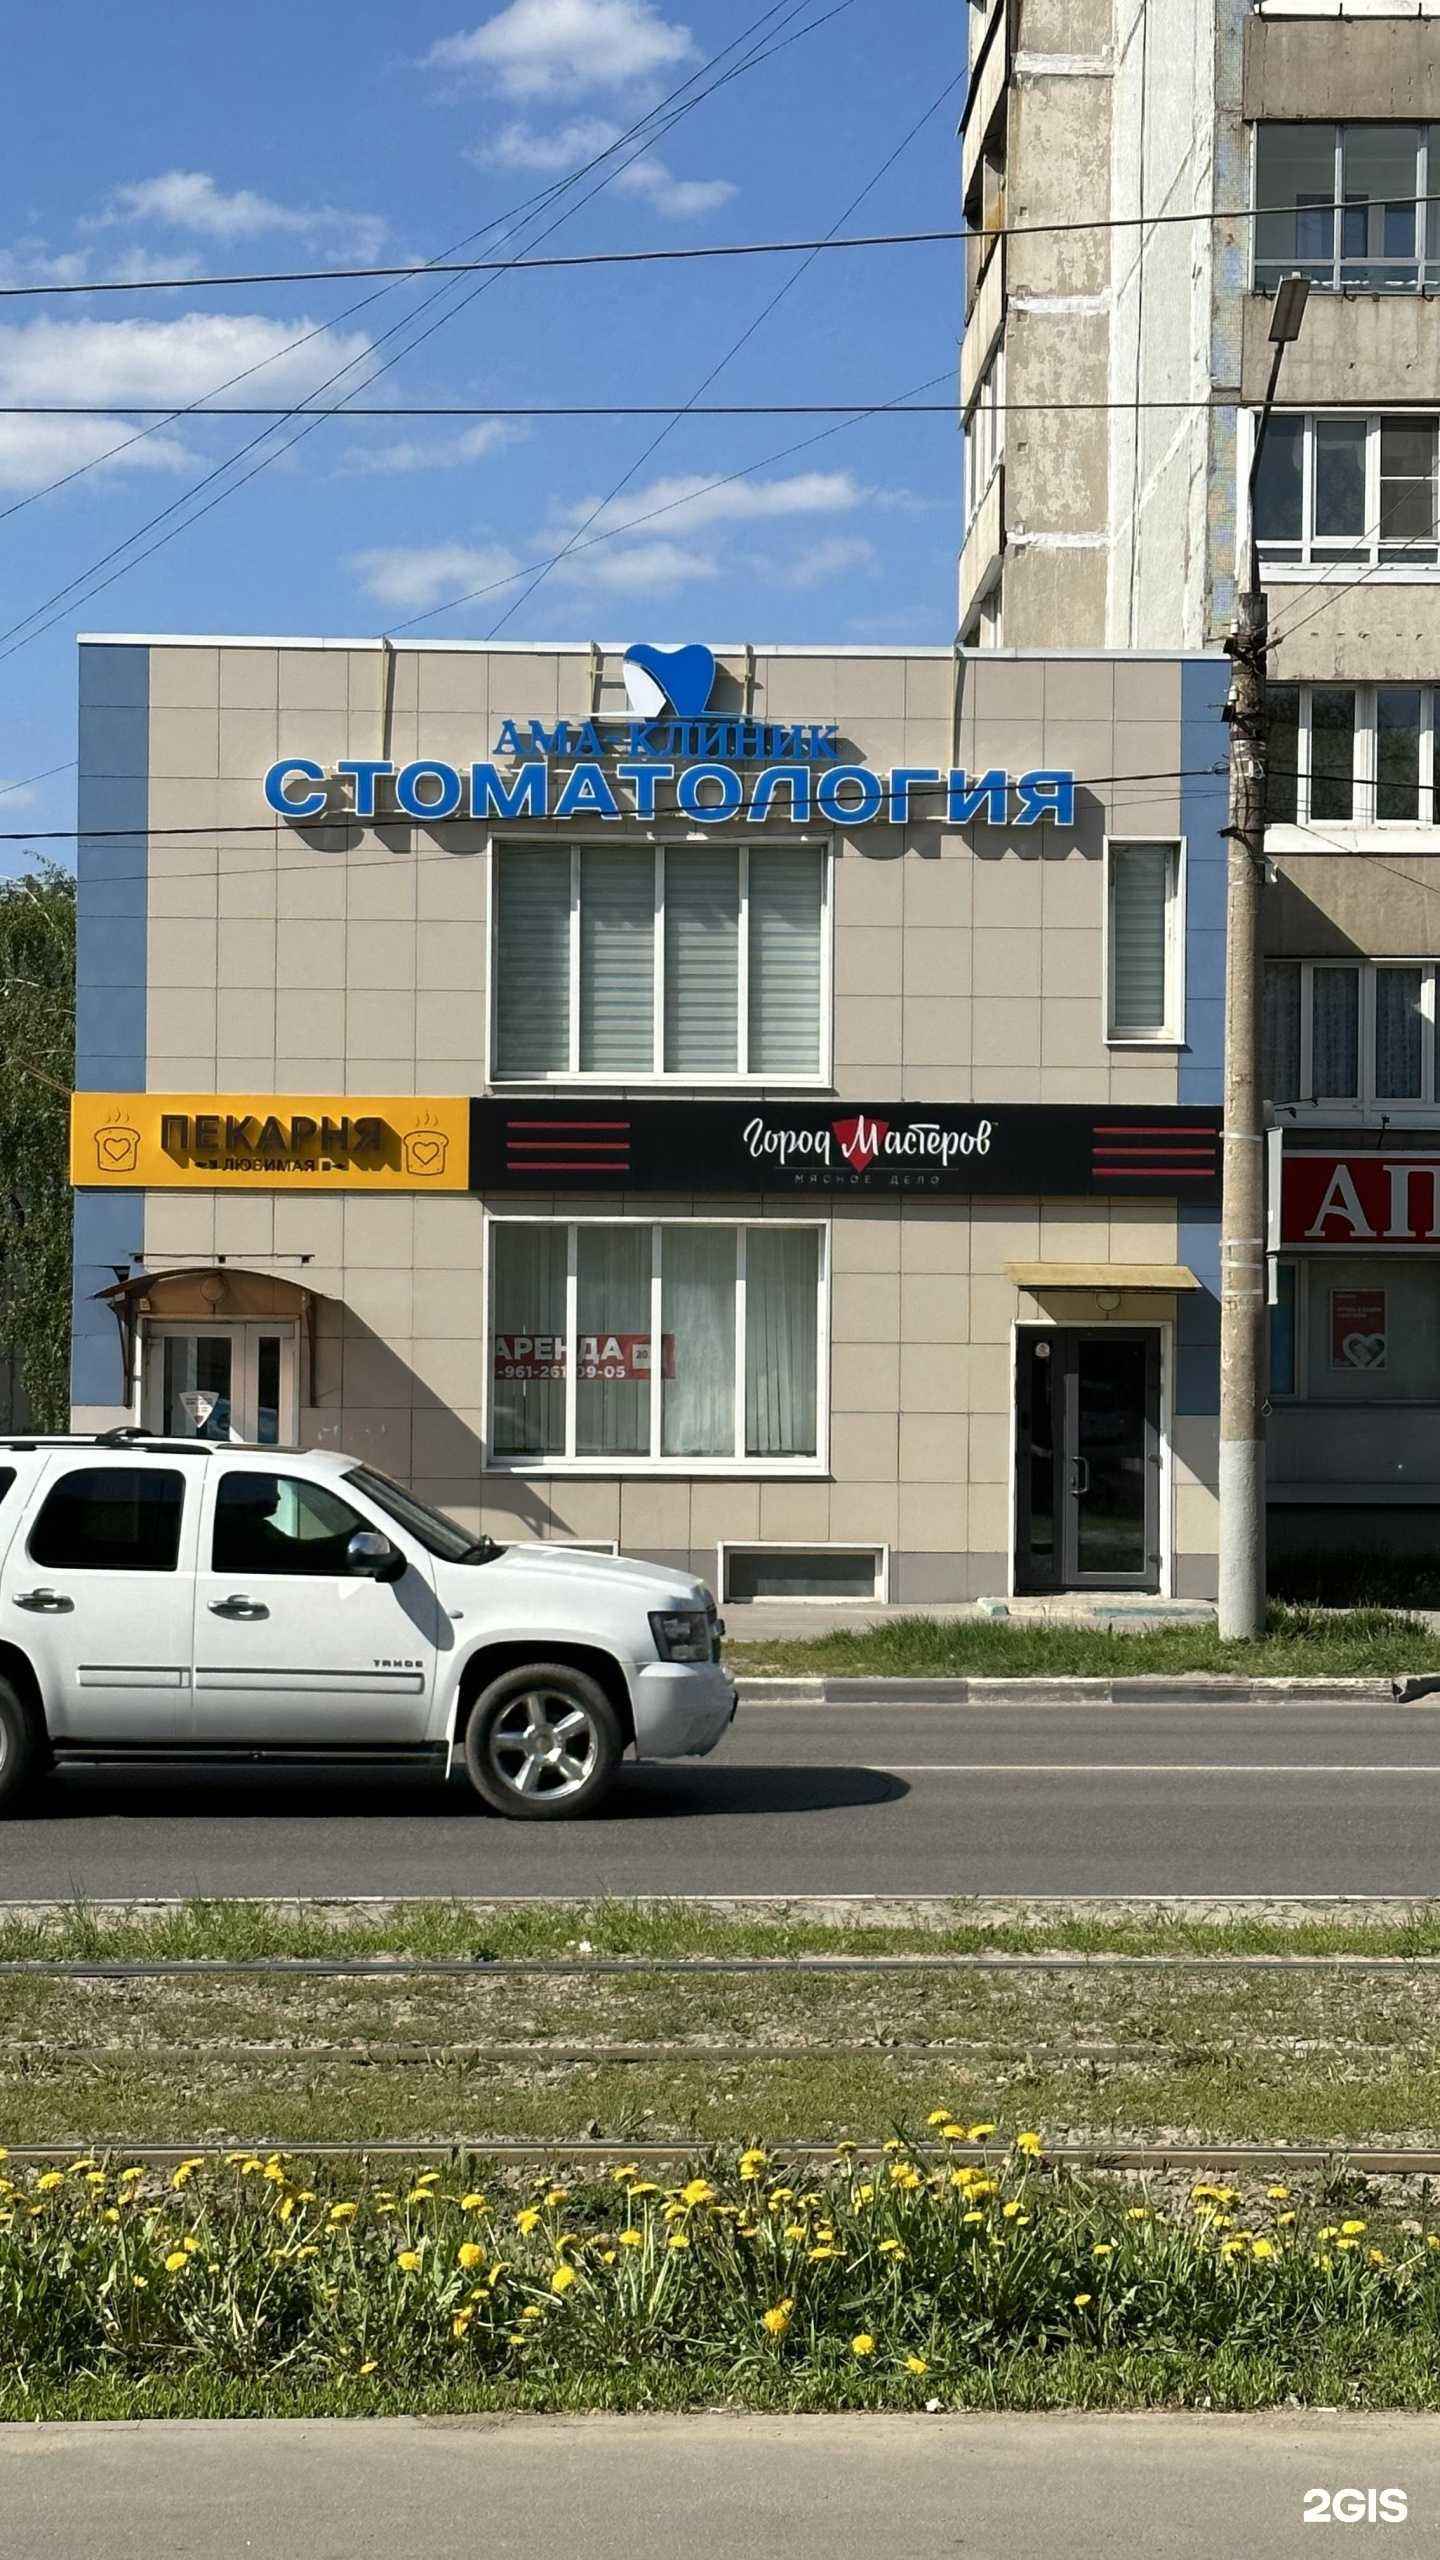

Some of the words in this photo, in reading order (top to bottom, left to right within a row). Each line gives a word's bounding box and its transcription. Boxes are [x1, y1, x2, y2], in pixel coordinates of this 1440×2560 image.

[494, 719, 840, 759] АМА-КЛИНИК
[262, 757, 1077, 826] СТОМАТОЛОГИЯ
[161, 1114, 383, 1153] ПЕКАРНЯ
[743, 1117, 831, 1165] Город
[842, 1114, 993, 1166] Мастеров
[222, 1158, 316, 1172] ЛЮБИМАЯ
[794, 1174, 873, 1184] МЯСНОЕ
[889, 1174, 941, 1185] ДЕЛО
[1304, 1164, 1440, 1237] АП
